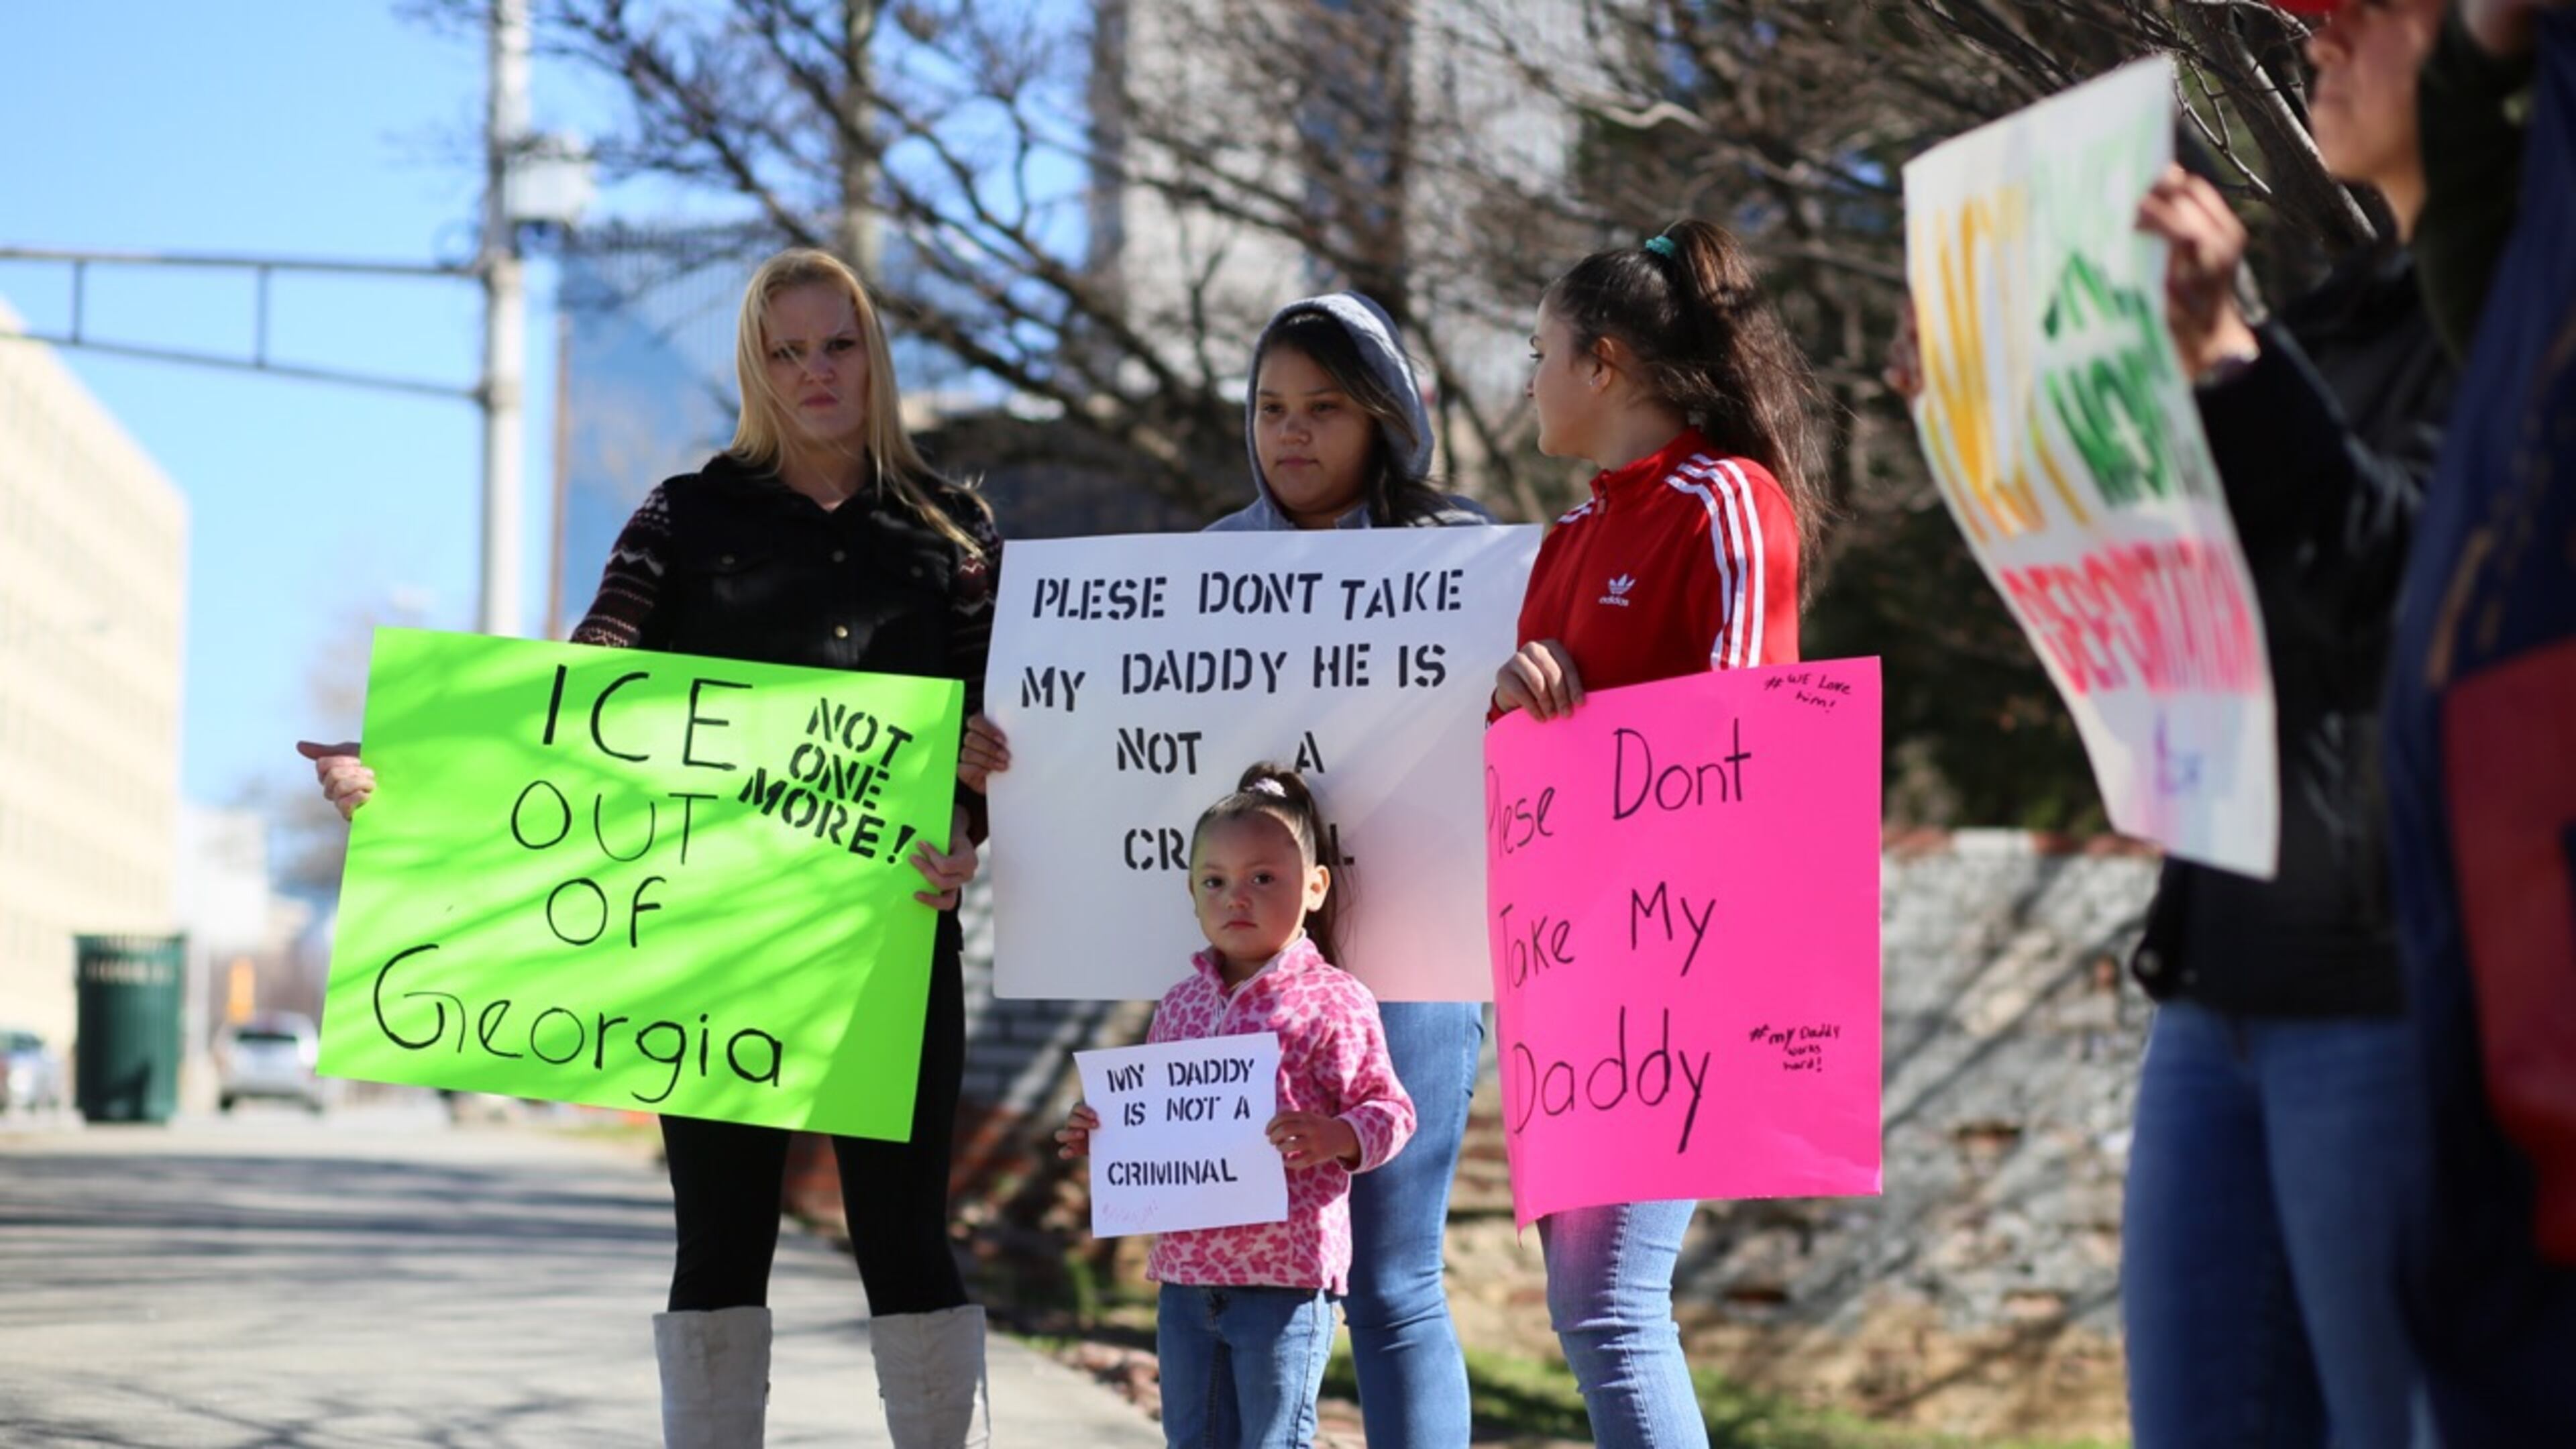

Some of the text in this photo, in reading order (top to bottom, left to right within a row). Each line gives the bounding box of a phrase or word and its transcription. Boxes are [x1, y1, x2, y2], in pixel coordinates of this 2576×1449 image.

[1032, 568, 1464, 621] PLESE DONT TAKE
[1021, 643, 1446, 712] MY DADDY HE IS
[542, 663, 754, 771] ICE
[805, 696, 914, 769] NOT
[1116, 727, 1326, 775] NOT A
[789, 742, 890, 810] ONE
[1613, 717, 1754, 822] Dont
[510, 780, 720, 865] OUT
[737, 766, 918, 865] MORE!
[545, 875, 667, 949] OF
[1499, 880, 1717, 994] Take My
[373, 943, 785, 1105] Georgia
[1106, 1058, 1255, 1093] MY DADDY
[1124, 1095, 1251, 1127] IS NOT A
[1512, 1005, 1712, 1155] Daddy
[1107, 1157, 1238, 1187] CRIMINAL
